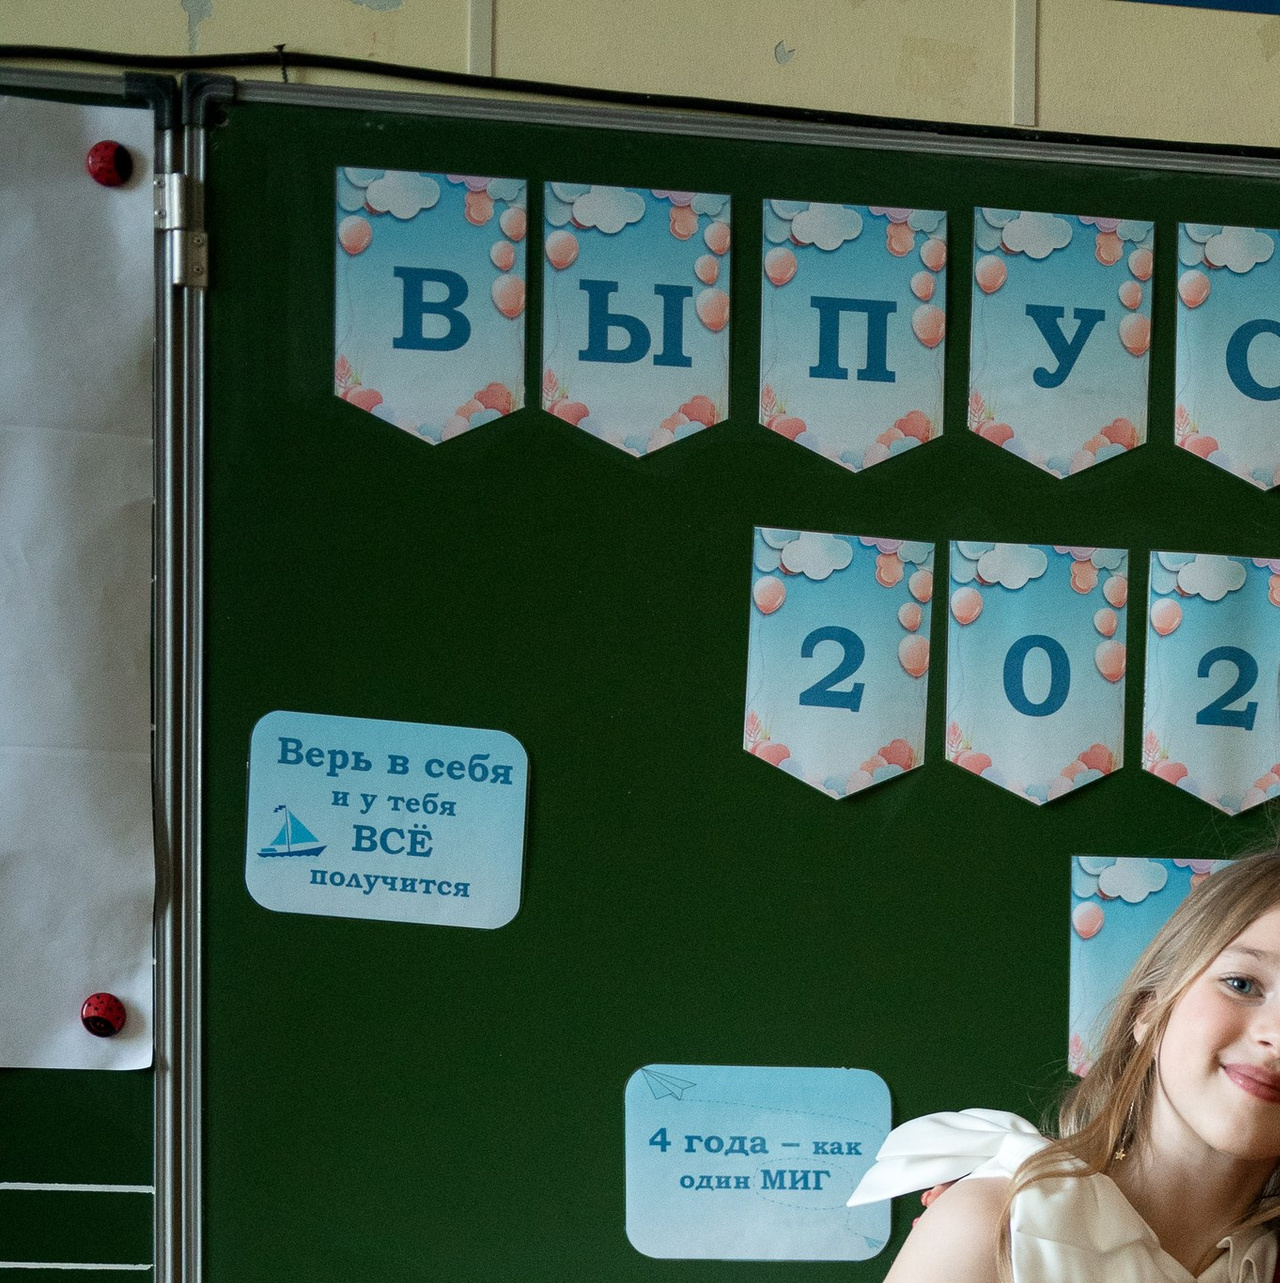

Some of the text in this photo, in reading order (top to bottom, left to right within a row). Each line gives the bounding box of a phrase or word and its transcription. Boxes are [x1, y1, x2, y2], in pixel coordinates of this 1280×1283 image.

[277, 736, 514, 785] Верь в себя
[331, 790, 457, 817] и у тебя
[351, 823, 433, 858] ВСЁ
[309, 869, 471, 898] получится
[648, 1127, 672, 1153] 4
[684, 1134, 769, 1157] года
[812, 1141, 863, 1156] как
[679, 1168, 832, 1192] один МИГ
